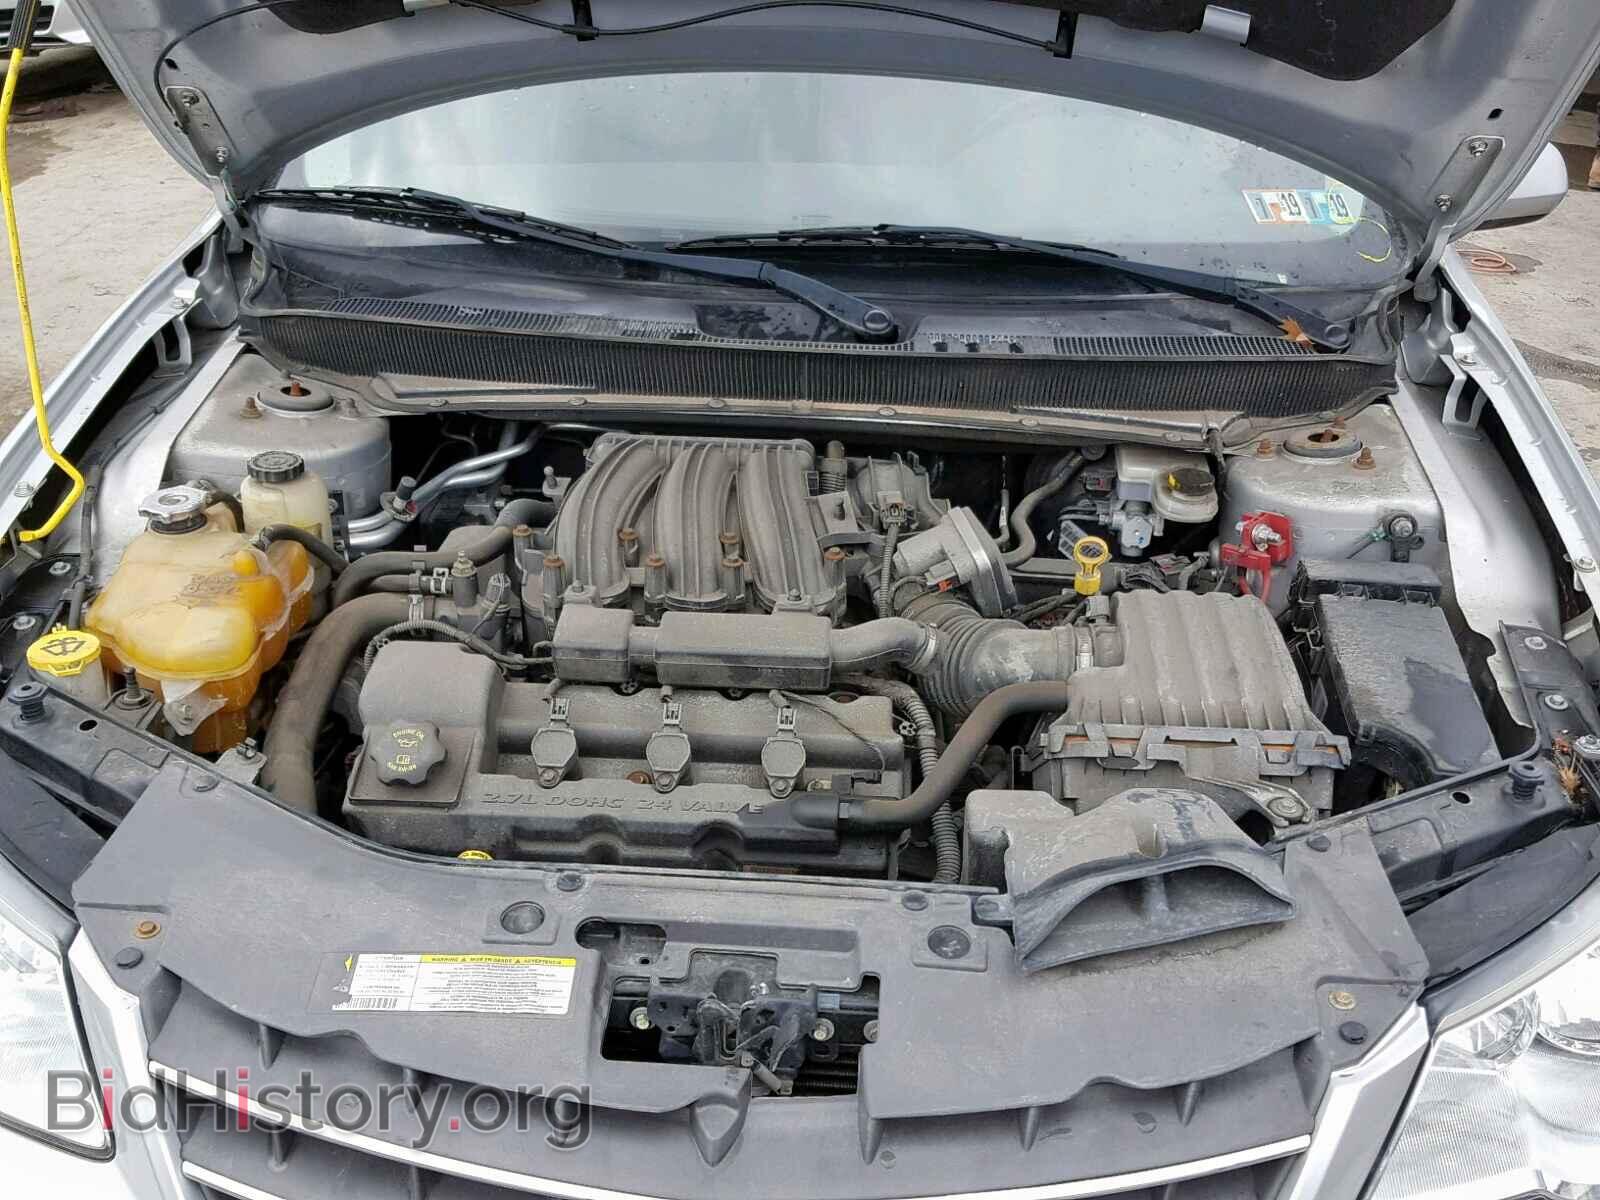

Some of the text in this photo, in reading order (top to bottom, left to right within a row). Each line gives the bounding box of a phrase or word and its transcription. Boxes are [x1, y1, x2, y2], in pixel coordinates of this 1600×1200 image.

[1280, 192, 1302, 217] 19
[1328, 193, 1350, 218] 19
[481, 792, 766, 815] 2.7L DOHC 24 VALVE
